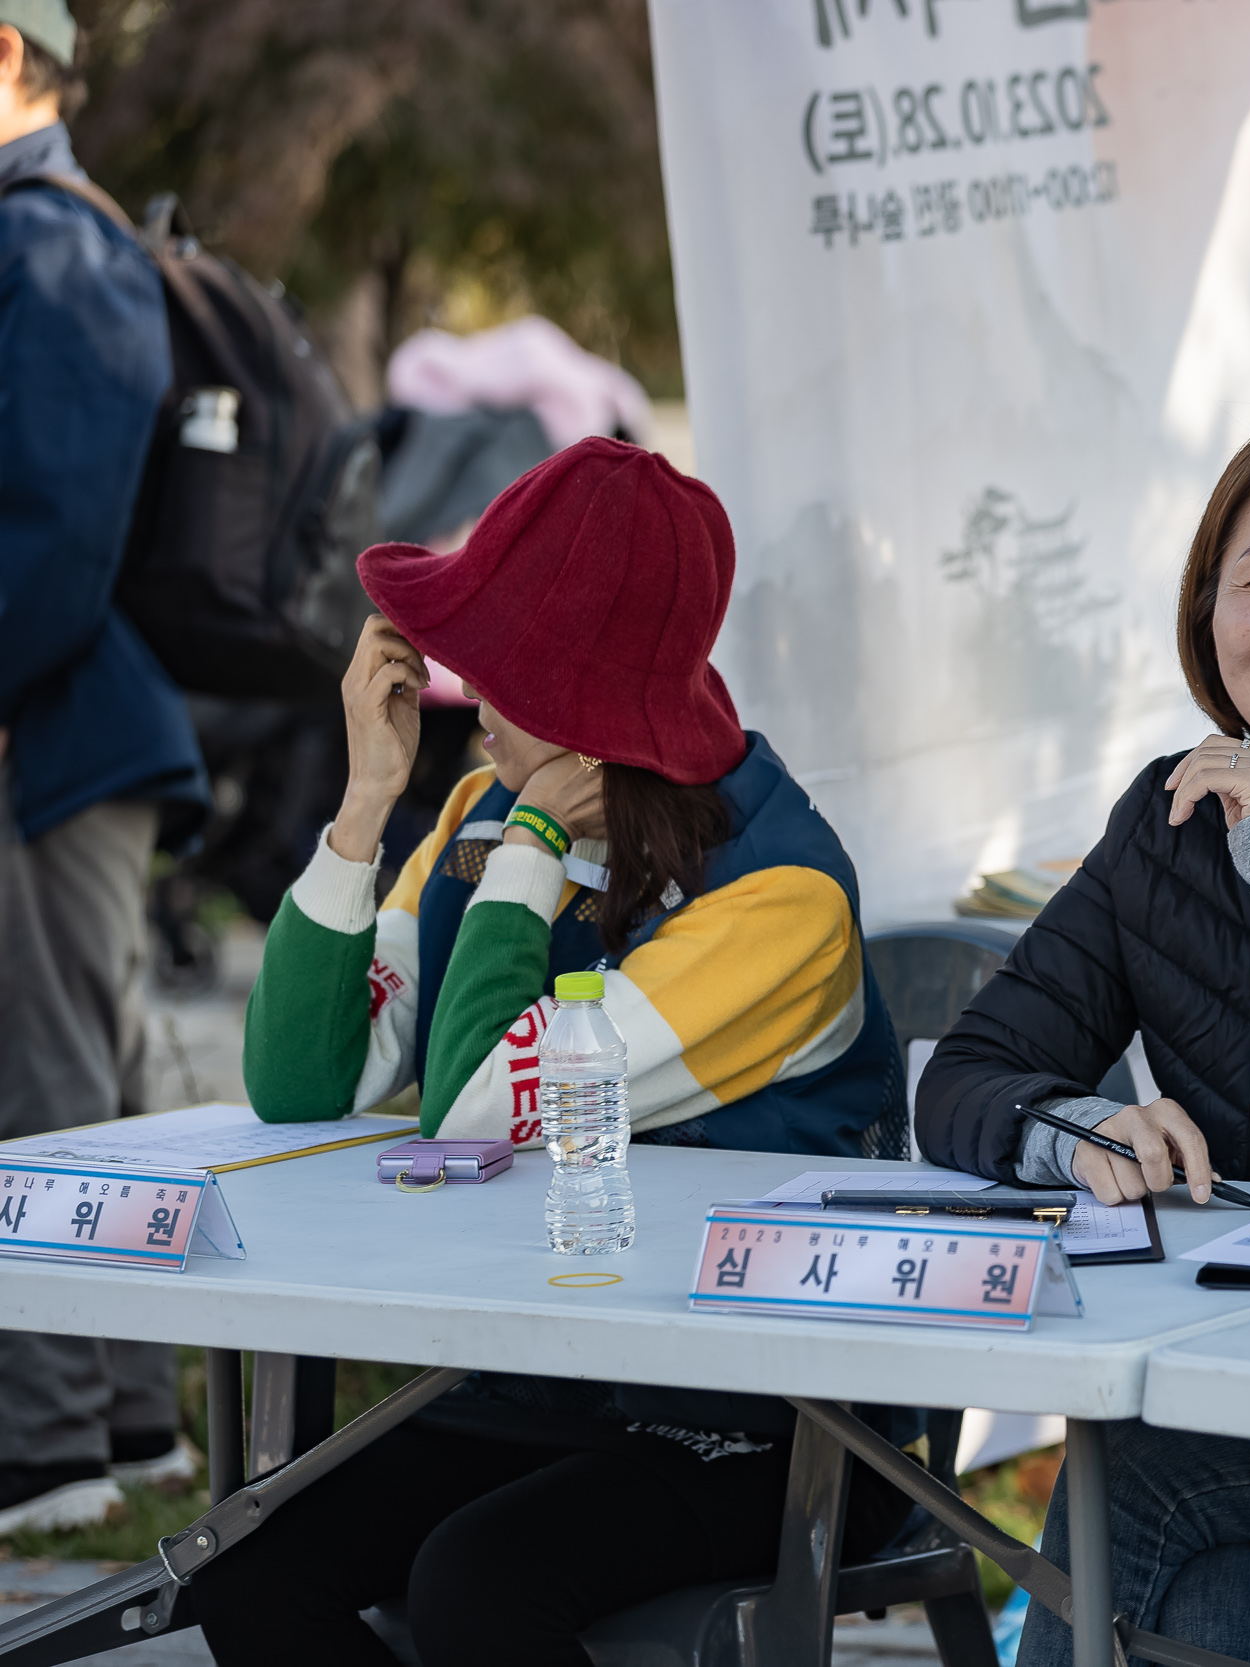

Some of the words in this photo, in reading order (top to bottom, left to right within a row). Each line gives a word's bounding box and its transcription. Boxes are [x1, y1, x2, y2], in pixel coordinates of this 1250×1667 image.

[4, 1175, 55, 1191] 광나루
[79, 1181, 131, 1198] 해오름
[156, 1188, 188, 1203] 축제
